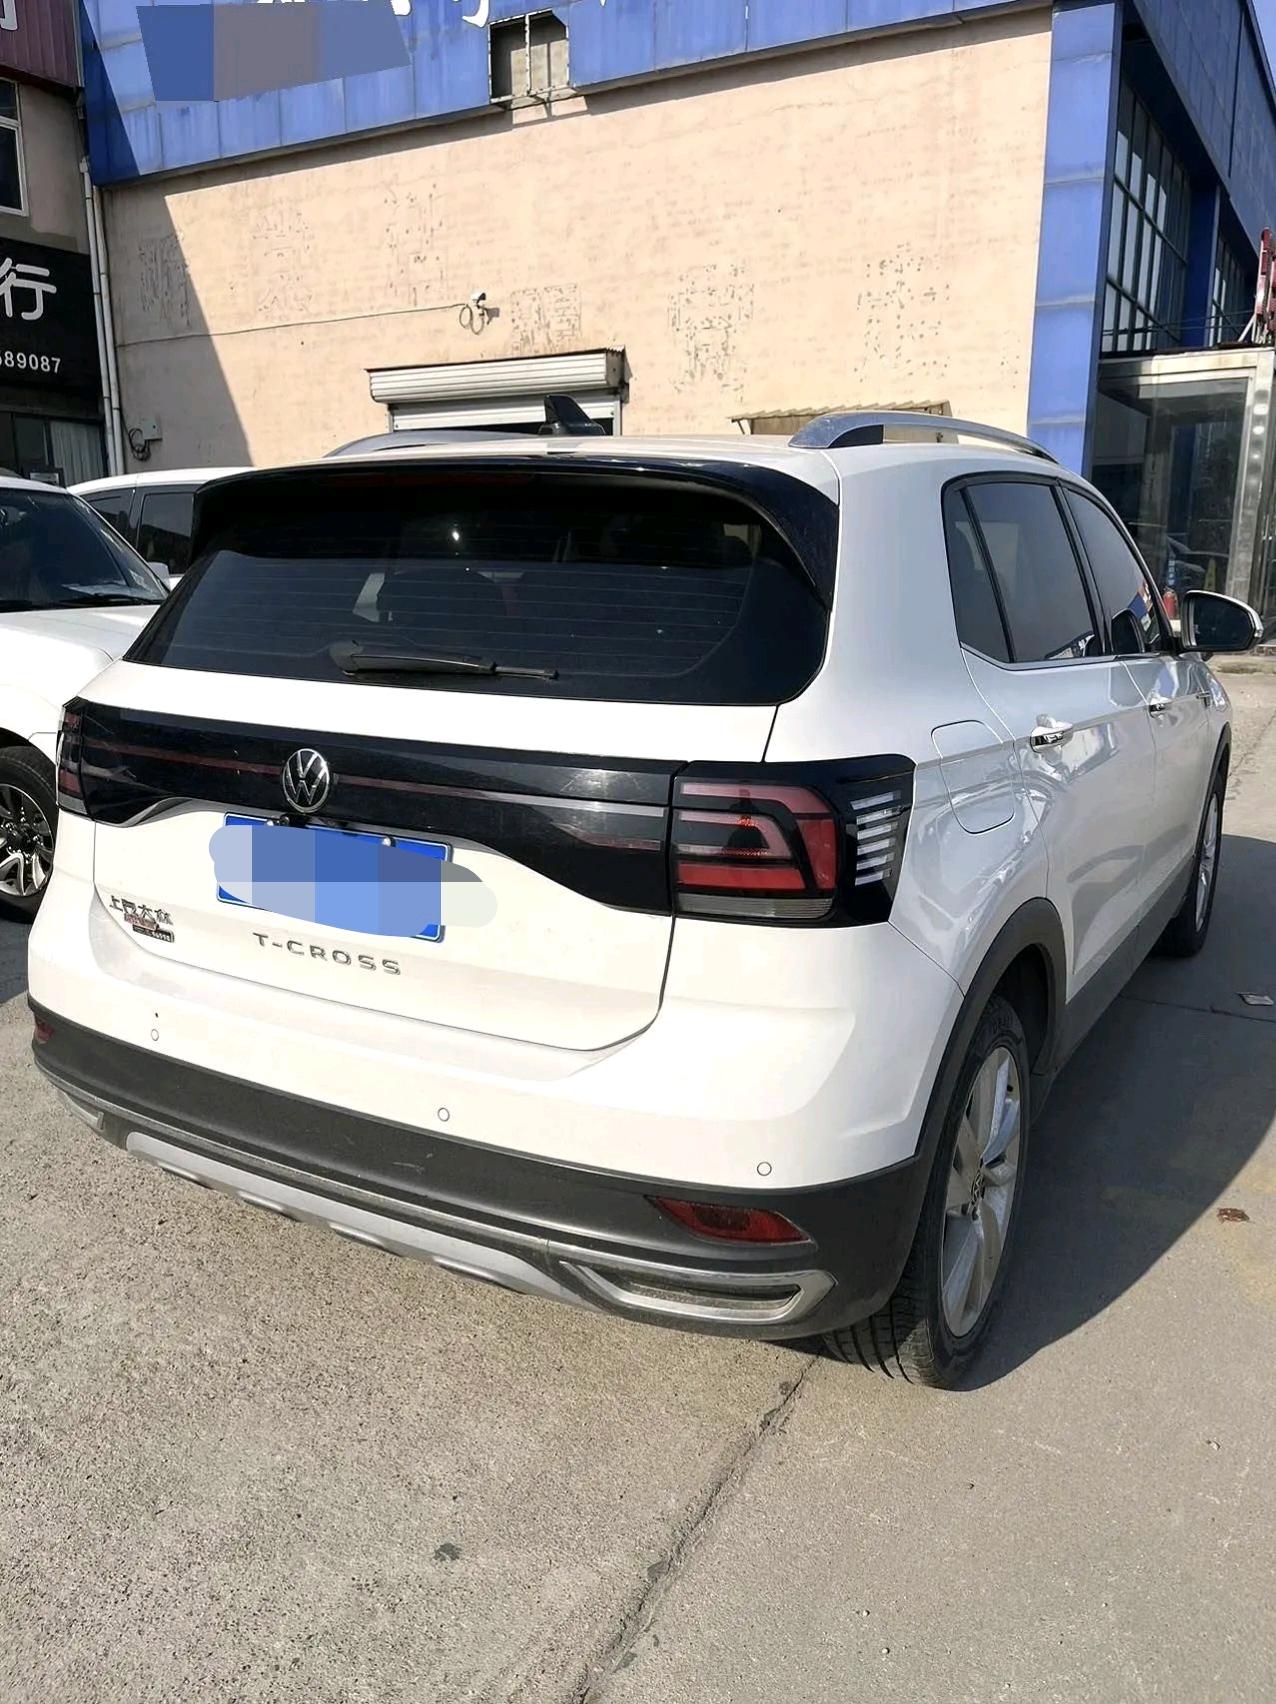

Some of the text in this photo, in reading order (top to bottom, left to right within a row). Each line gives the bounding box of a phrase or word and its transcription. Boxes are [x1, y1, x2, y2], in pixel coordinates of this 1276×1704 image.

[0, 257, 57, 320] 行
[0, 350, 61, 374] 89087
[252, 932, 401, 976] T-CROSS
